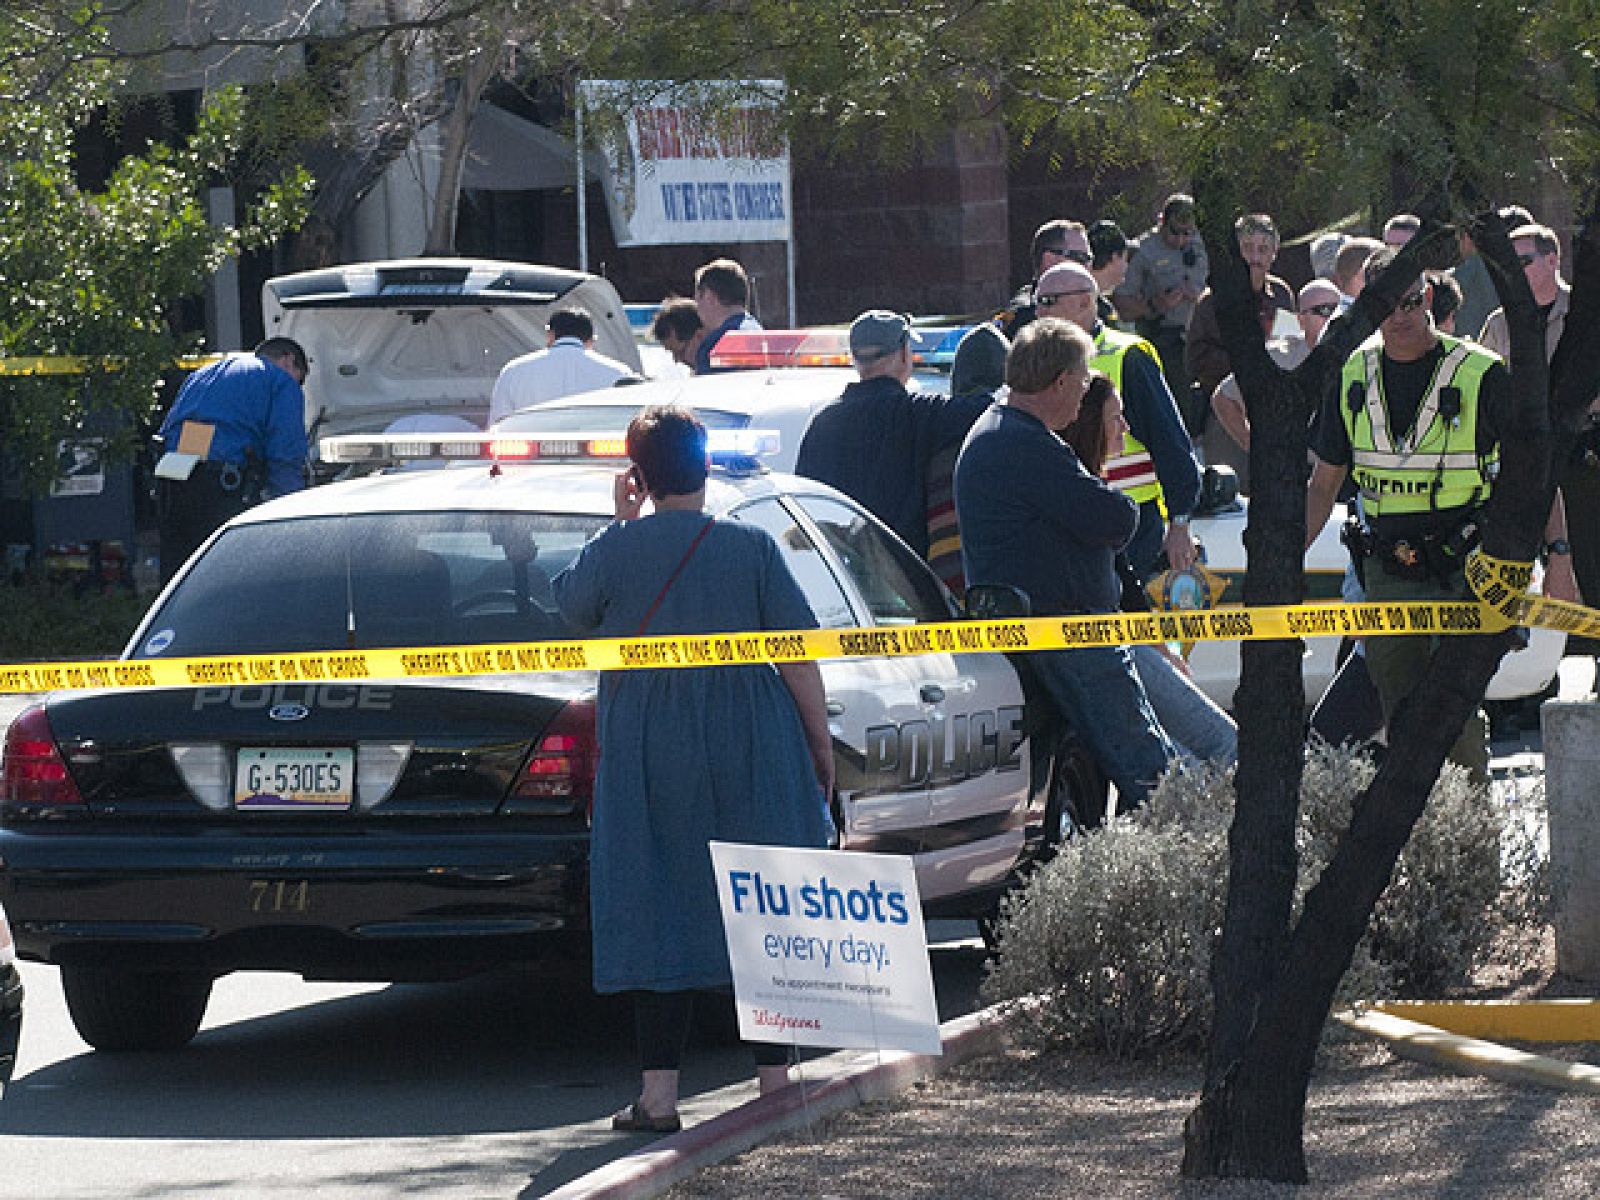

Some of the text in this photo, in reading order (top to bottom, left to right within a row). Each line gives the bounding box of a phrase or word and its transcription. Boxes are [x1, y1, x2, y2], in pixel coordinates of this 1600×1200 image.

[1062, 612, 1253, 644] SHERIFF'S LINE DO NOT CROSS
[1287, 605, 1480, 632] SHERIFF'S LINE DO NOT CROSS
[620, 635, 805, 665] SHERIFF'S LINE DO NOT CROSS
[839, 624, 1028, 655] SHERIFF'S LINE DO NOT CROSS
[250, 659, 279, 681] LINE
[328, 655, 369, 678] CROSS
[401, 646, 587, 675] SHERIFF'S LINE DO NOT CROSS
[35, 669, 65, 689] LINE
[115, 664, 155, 685] CROSS
[192, 685, 396, 711] POLICE
[865, 705, 1023, 790] POLICE
[249, 764, 341, 792] G-530ES
[251, 880, 310, 912] 714
[729, 870, 911, 926] Flu shots
[764, 933, 891, 971] every day.
